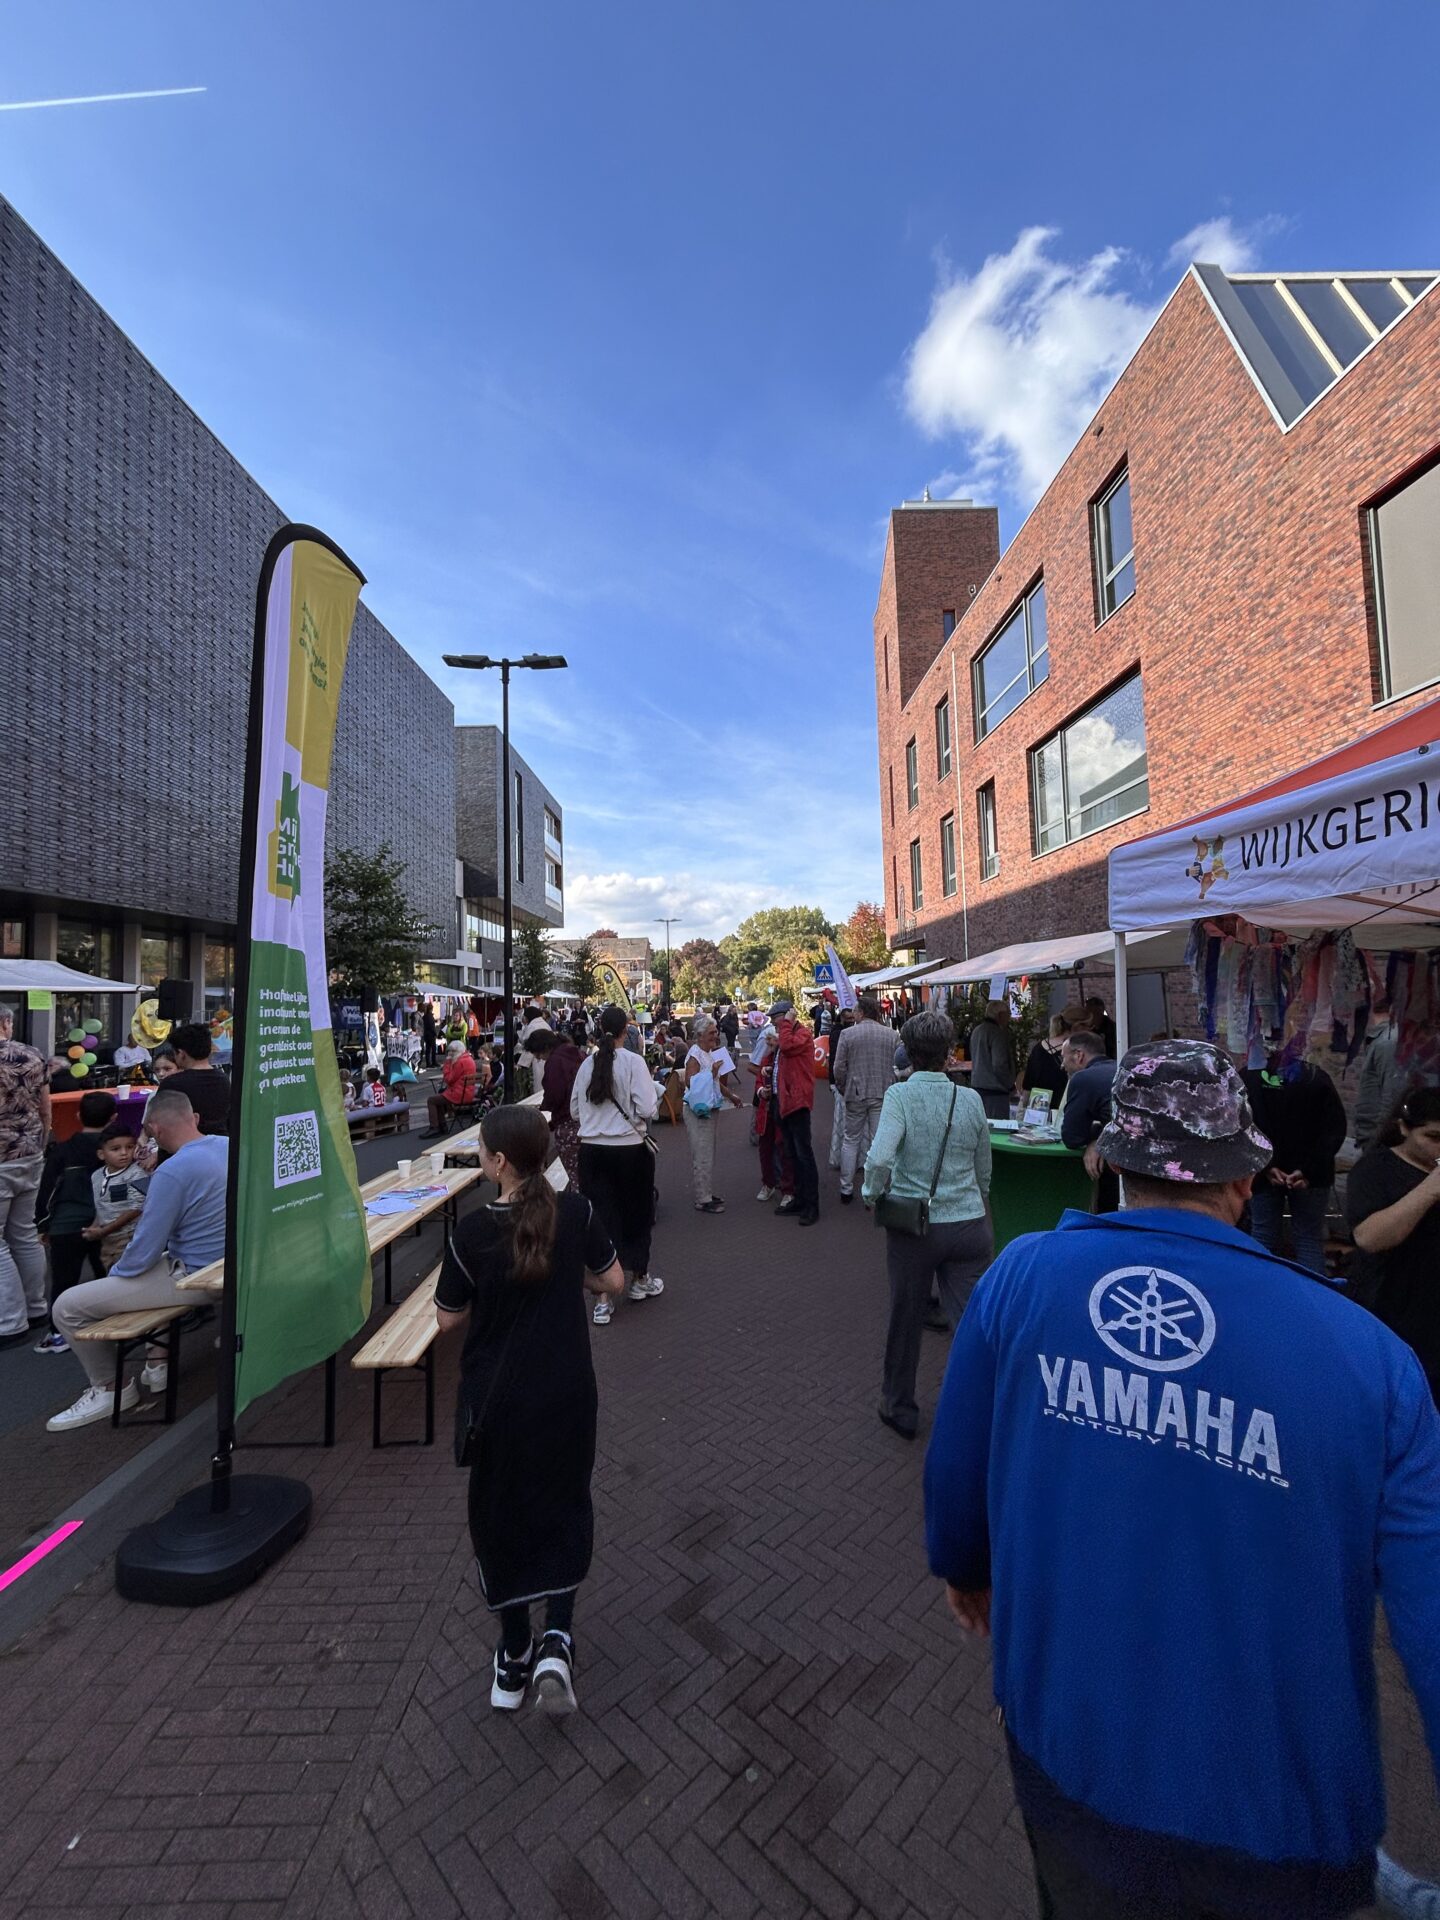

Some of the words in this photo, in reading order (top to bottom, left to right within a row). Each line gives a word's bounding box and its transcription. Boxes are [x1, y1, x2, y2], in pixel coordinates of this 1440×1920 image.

[1240, 781, 1440, 870] WIJKGERI
[1037, 1353, 1282, 1475] YAMAHA
[1043, 1408, 1163, 1445] FACTORY
[1175, 1440, 1290, 1488] RACING
